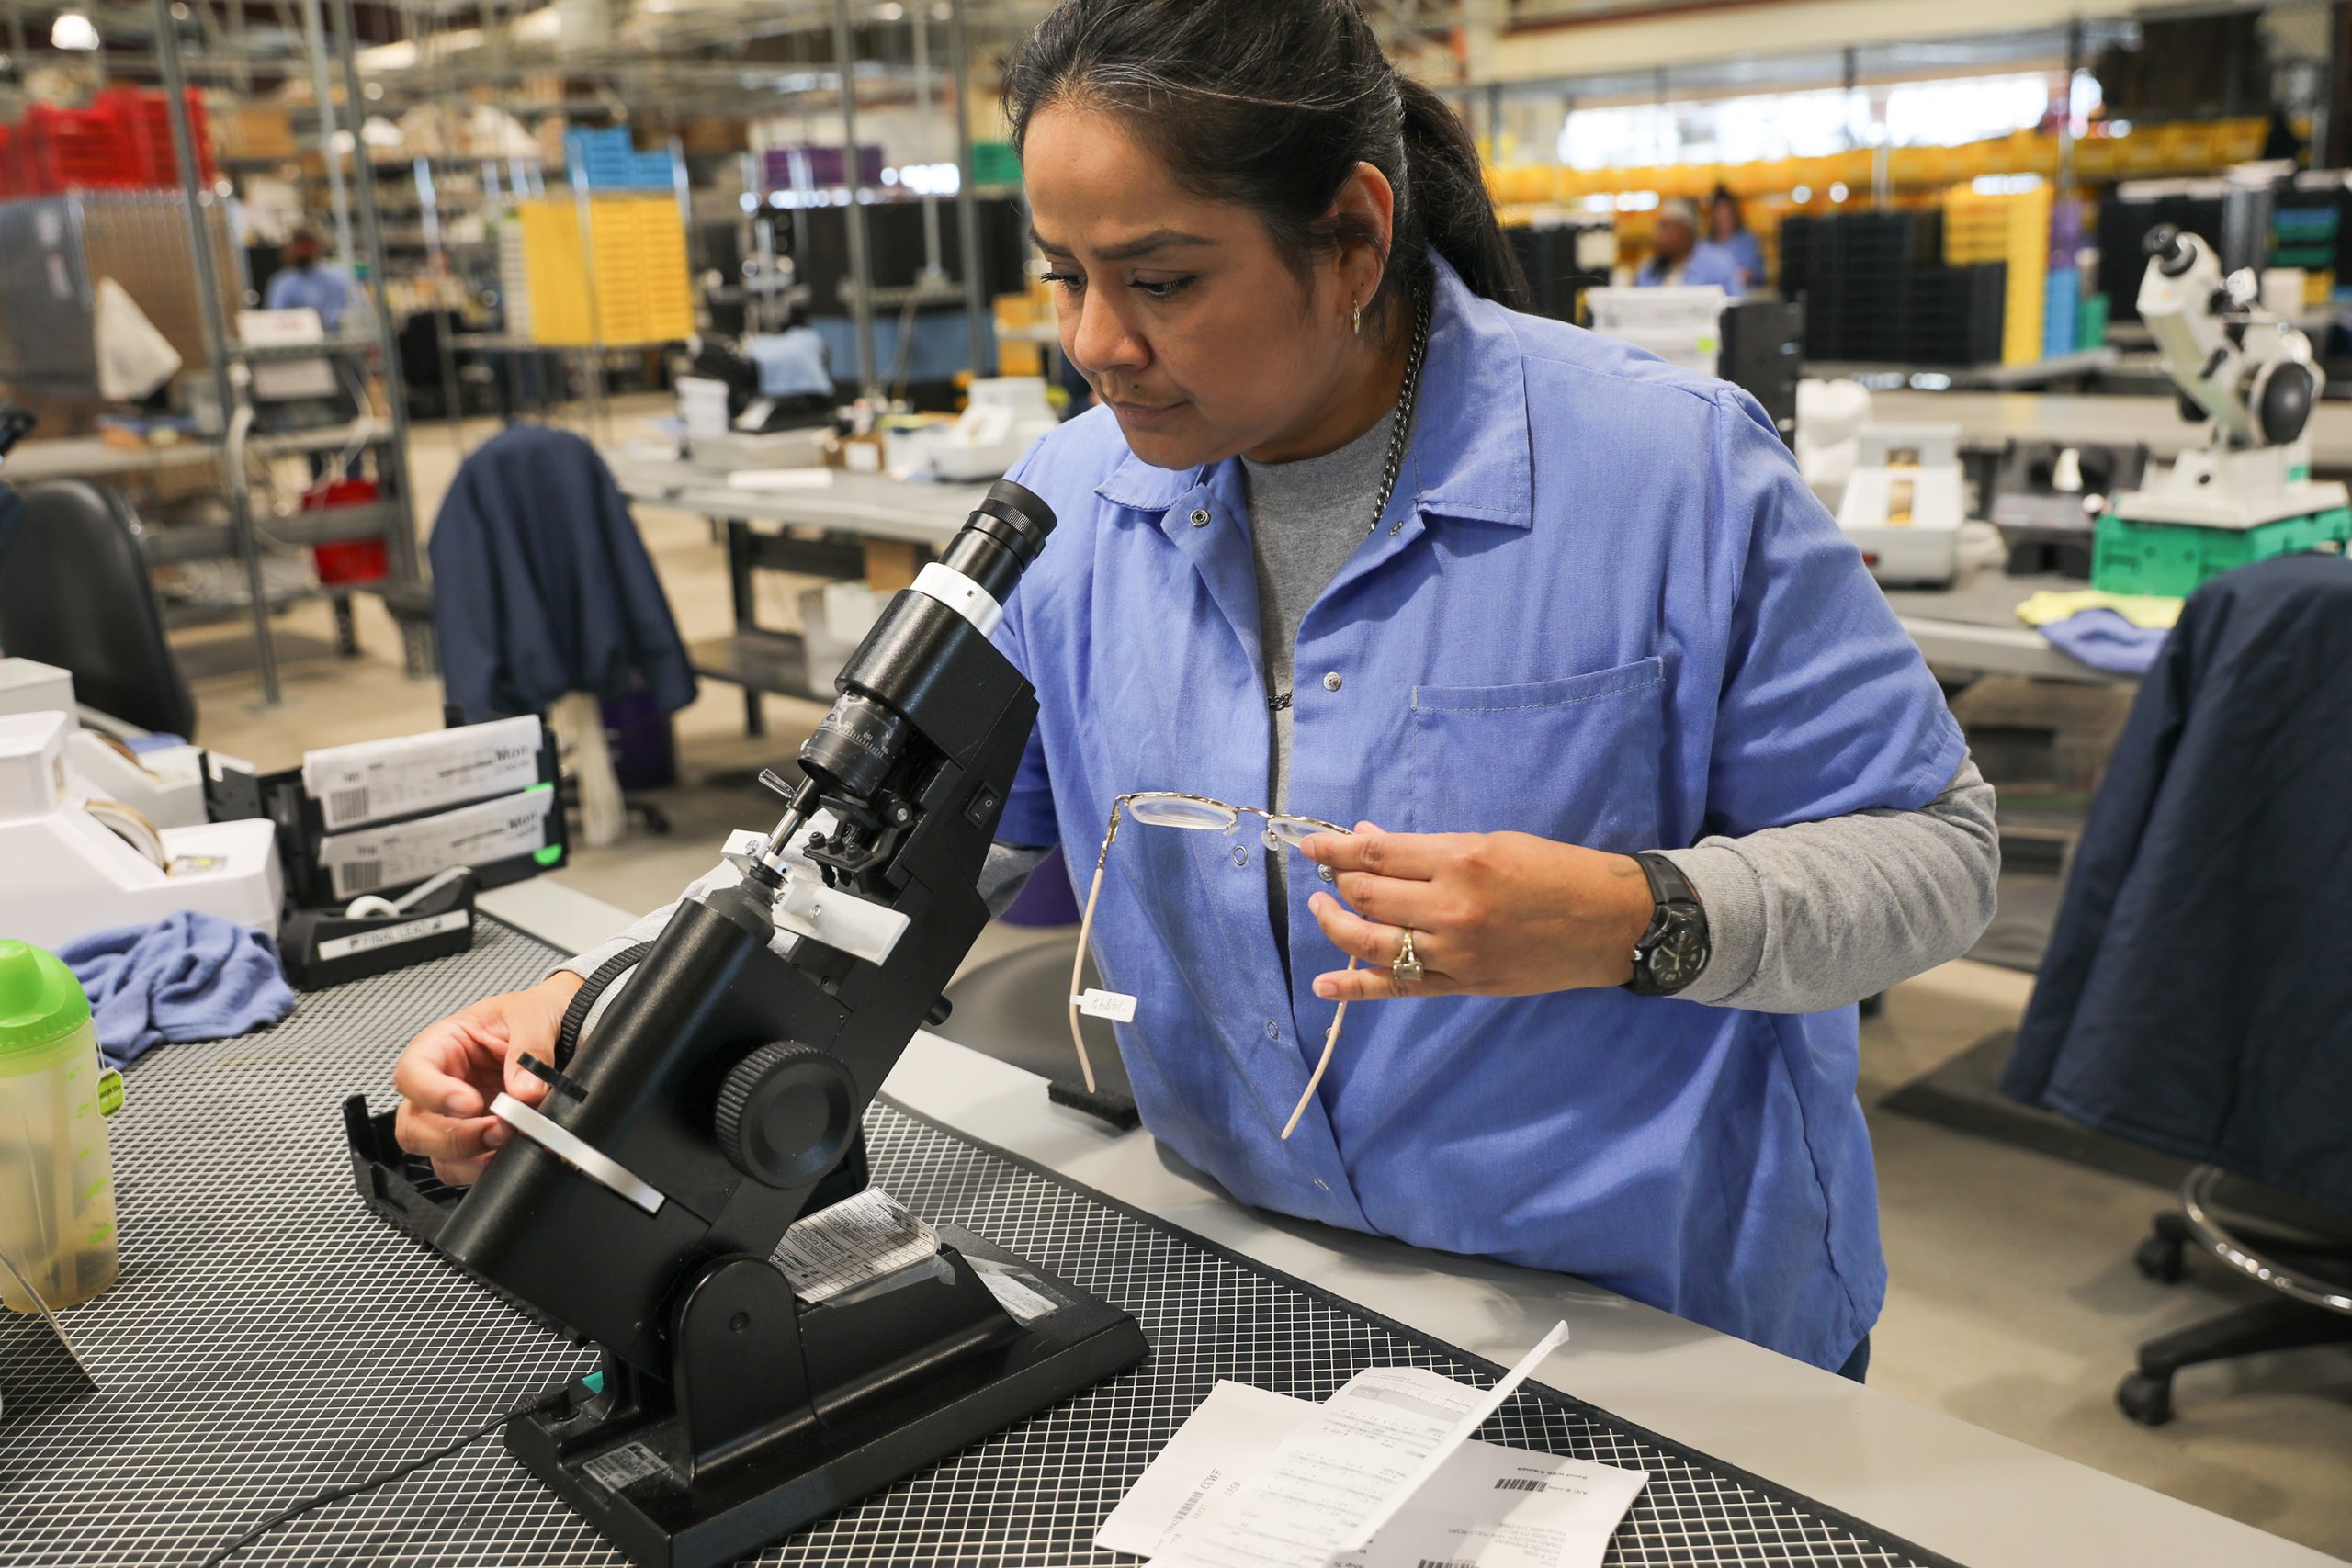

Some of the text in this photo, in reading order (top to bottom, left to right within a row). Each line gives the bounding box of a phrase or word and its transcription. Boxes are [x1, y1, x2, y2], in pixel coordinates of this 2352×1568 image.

[863, 731, 873, 741] 150
[1200, 1468, 1221, 1490] CCWF
[1224, 1481, 1241, 1497] 0358
[1448, 1528, 1469, 1536] ROAD
